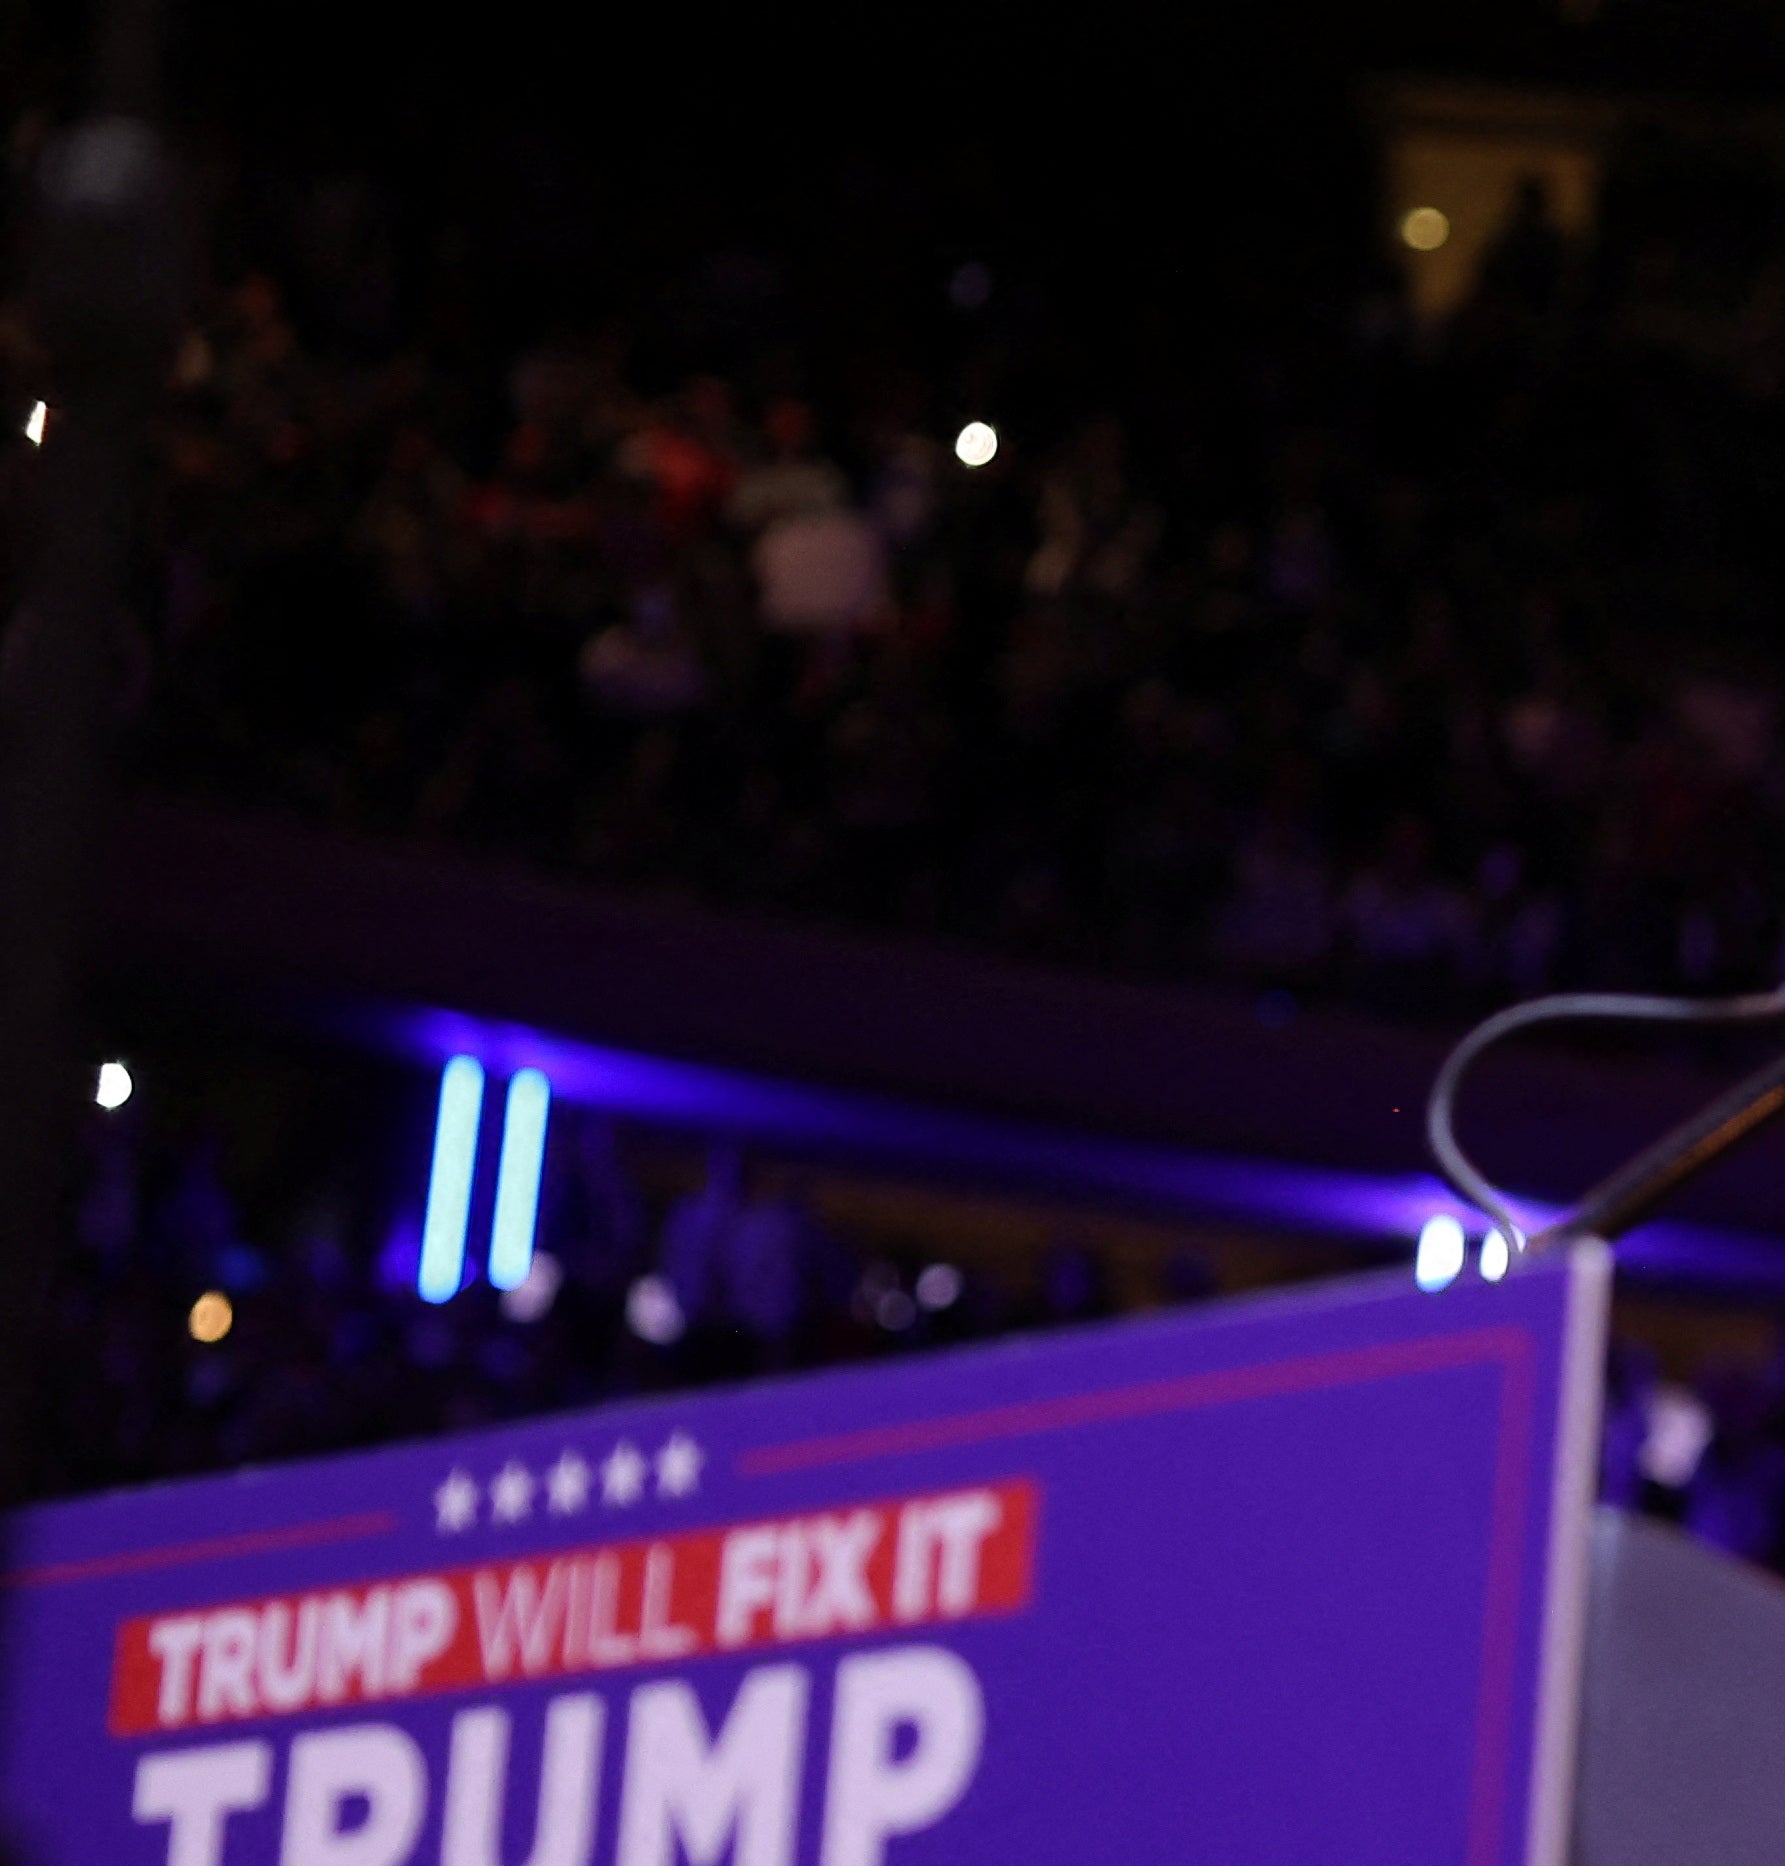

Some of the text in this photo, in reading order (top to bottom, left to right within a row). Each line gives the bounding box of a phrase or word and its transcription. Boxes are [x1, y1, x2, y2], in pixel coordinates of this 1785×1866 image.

[149, 1486, 999, 1729] TRUMP WILL FIX IT
